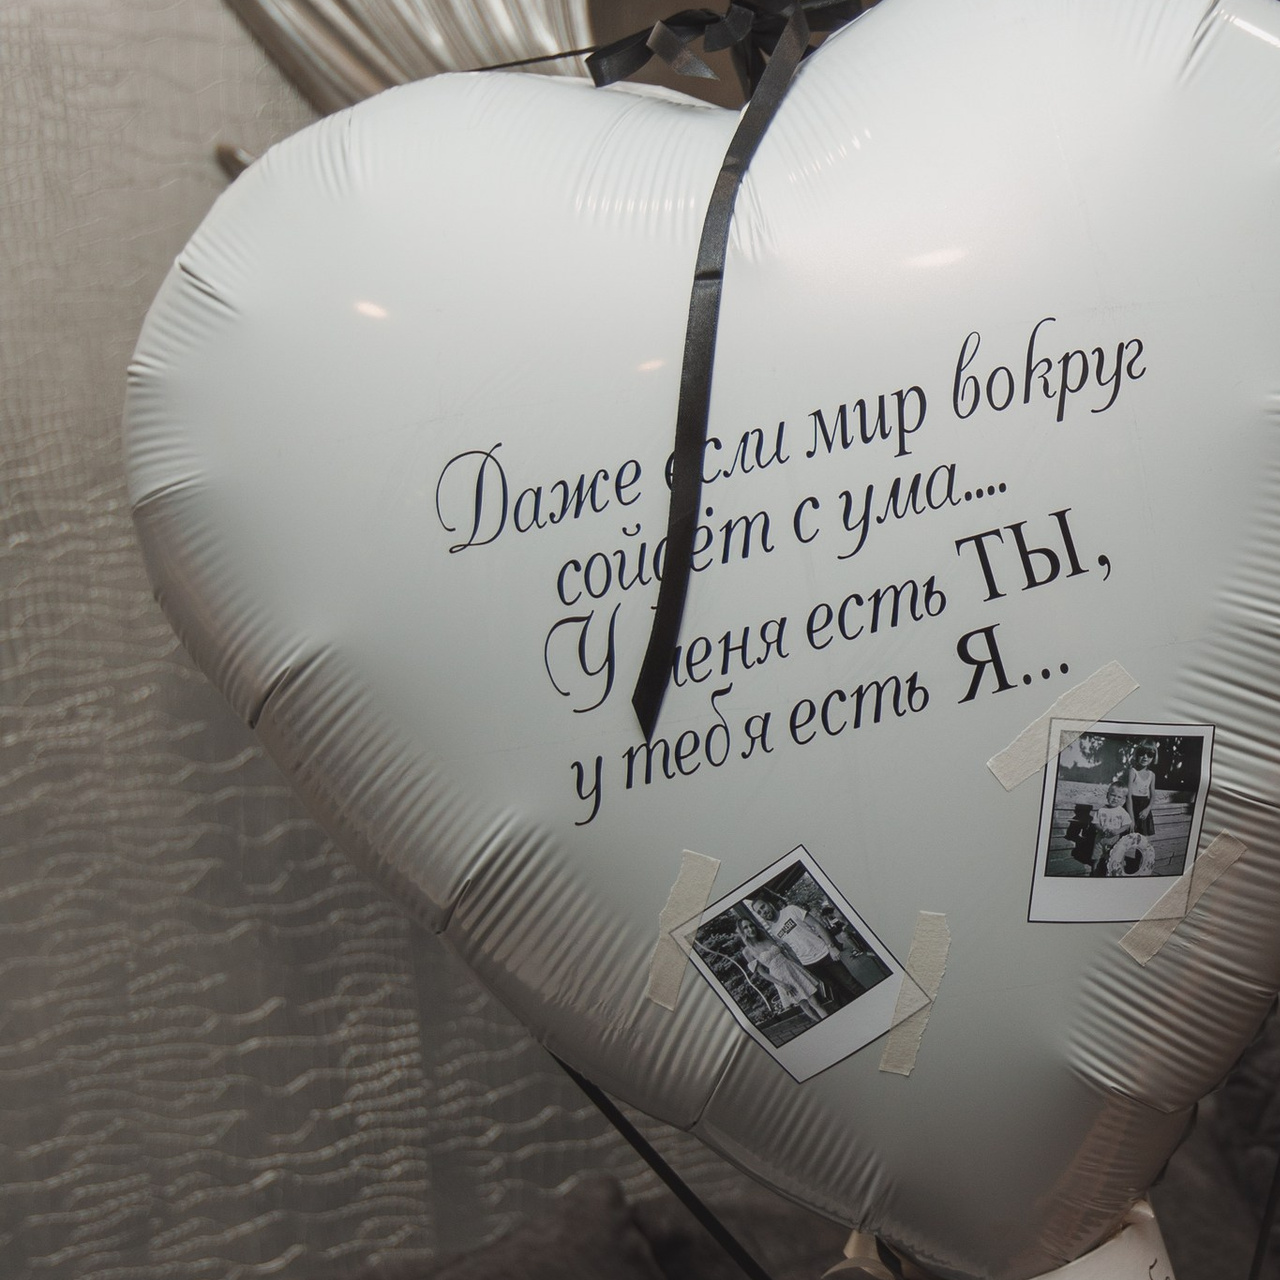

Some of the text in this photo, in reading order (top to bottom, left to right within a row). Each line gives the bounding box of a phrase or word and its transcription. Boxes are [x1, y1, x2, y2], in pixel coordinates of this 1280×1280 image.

[435, 442, 642, 554] Даже
[805, 385, 928, 459] мир
[952, 317, 1147, 422] вокруг
[794, 497, 820, 544] с
[837, 463, 1007, 561] ума....
[544, 604, 616, 713] У
[807, 575, 946, 651] есть
[955, 508, 1112, 603] ТЫ,
[571, 623, 1069, 826] у тебя есть Я...
